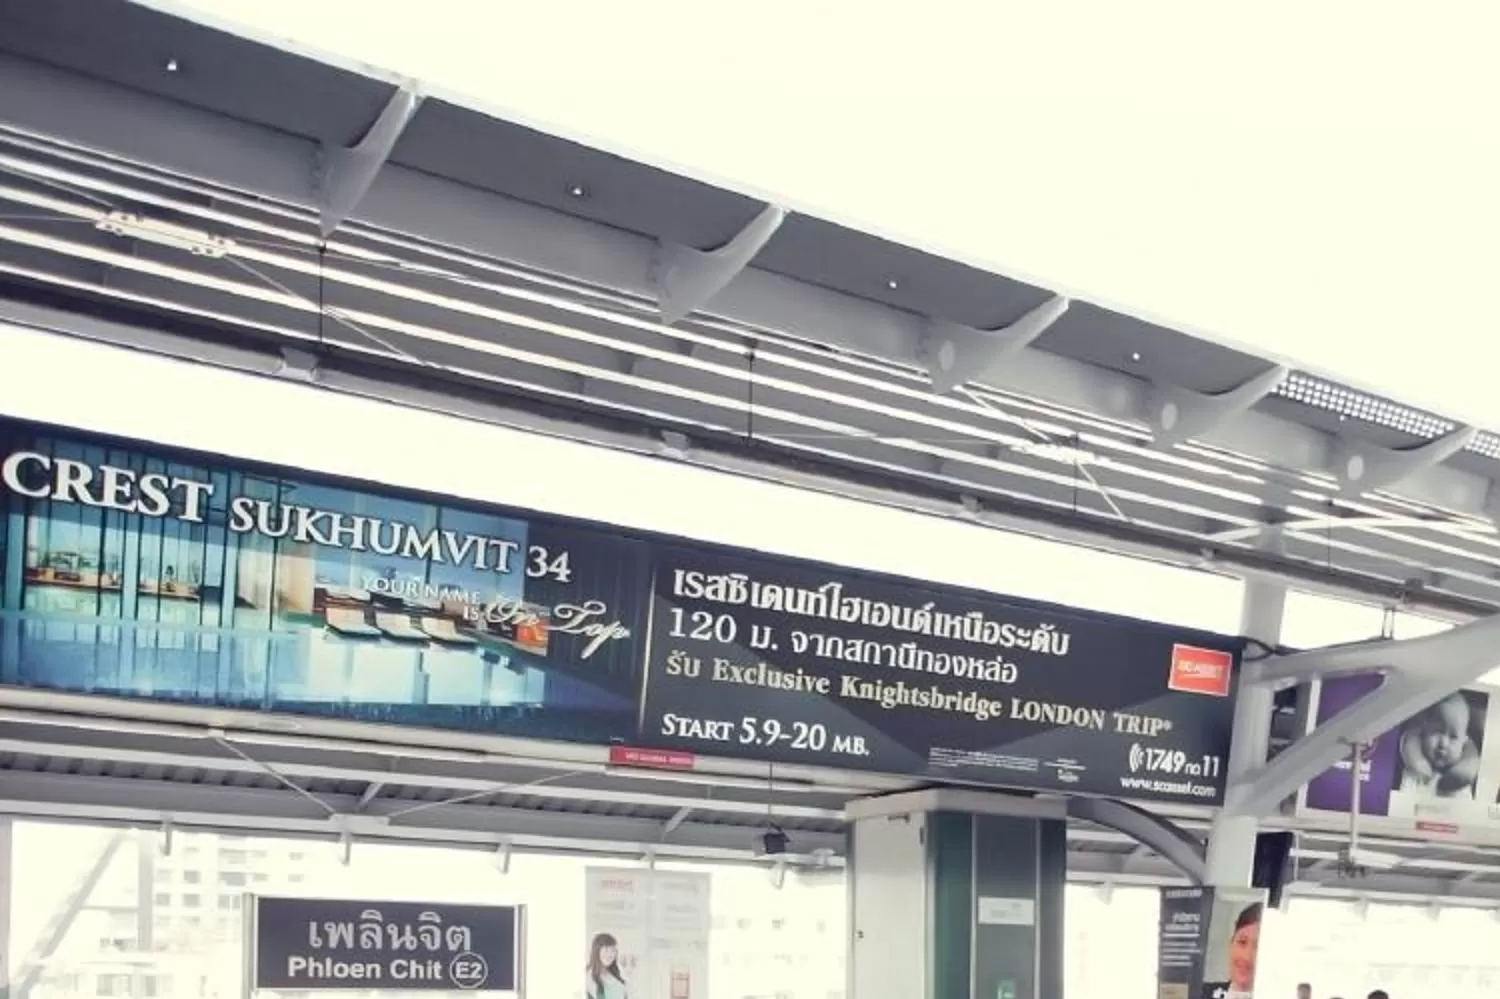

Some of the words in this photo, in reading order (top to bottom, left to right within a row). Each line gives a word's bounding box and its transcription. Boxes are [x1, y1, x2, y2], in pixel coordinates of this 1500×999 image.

[1, 451, 214, 523] CREST
[229, 497, 519, 575] SUKHUMVIT
[525, 545, 572, 583] 34
[361, 575, 419, 598] YOUR
[424, 584, 481, 605] NAME
[668, 607, 737, 643] 120
[749, 623, 779, 651] ม.
[665, 650, 700, 678] รับ
[712, 657, 831, 694] Exclusive
[839, 675, 1003, 721] Knightsbridge
[1009, 697, 1106, 732] LONDON
[739, 717, 827, 751] 5.9-20
[831, 735, 871, 756] MB.
[1145, 747, 1186, 774] 1749
[308, 909, 472, 952] เพลินจิต
[288, 955, 382, 981] Phloen
[390, 959, 443, 980] Chit
[455, 961, 483, 979] E2
